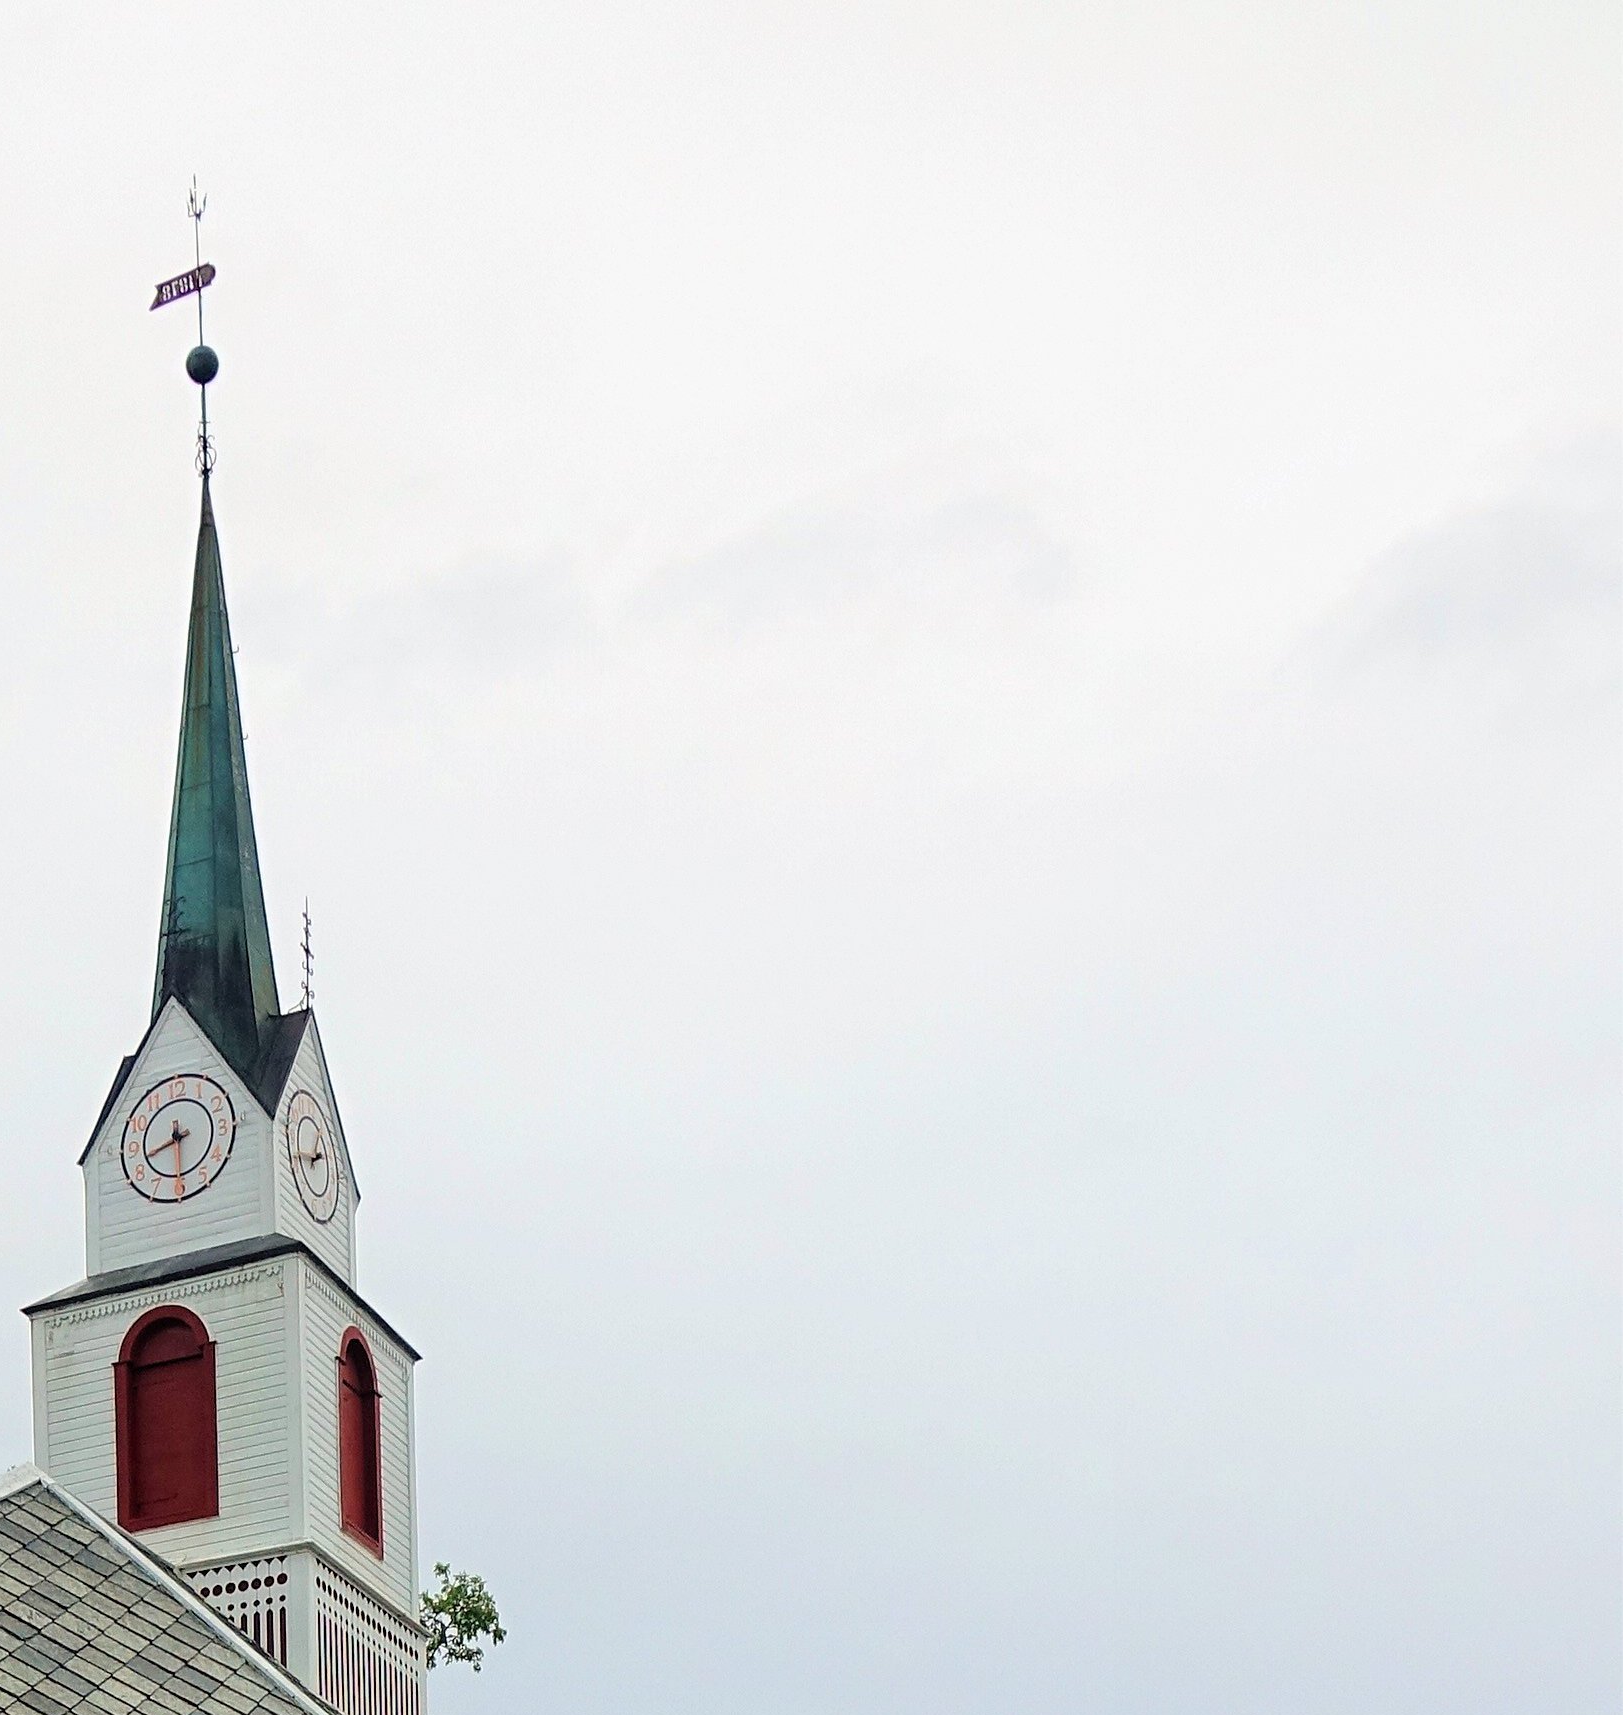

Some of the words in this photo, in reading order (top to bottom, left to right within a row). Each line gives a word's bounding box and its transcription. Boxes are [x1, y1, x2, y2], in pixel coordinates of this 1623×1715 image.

[167, 1081, 186, 1099] 12
[195, 1083, 202, 1099] 1
[147, 1093, 161, 1112] 11
[211, 1096, 224, 1113] 2
[130, 1115, 147, 1133] 10
[218, 1119, 228, 1136] 3
[128, 1141, 139, 1159] 9
[210, 1144, 221, 1162] 4
[135, 1164, 145, 1181] 8
[198, 1166, 208, 1184] 5
[151, 1177, 162, 1196] 7
[174, 1177, 186, 1196] 6
